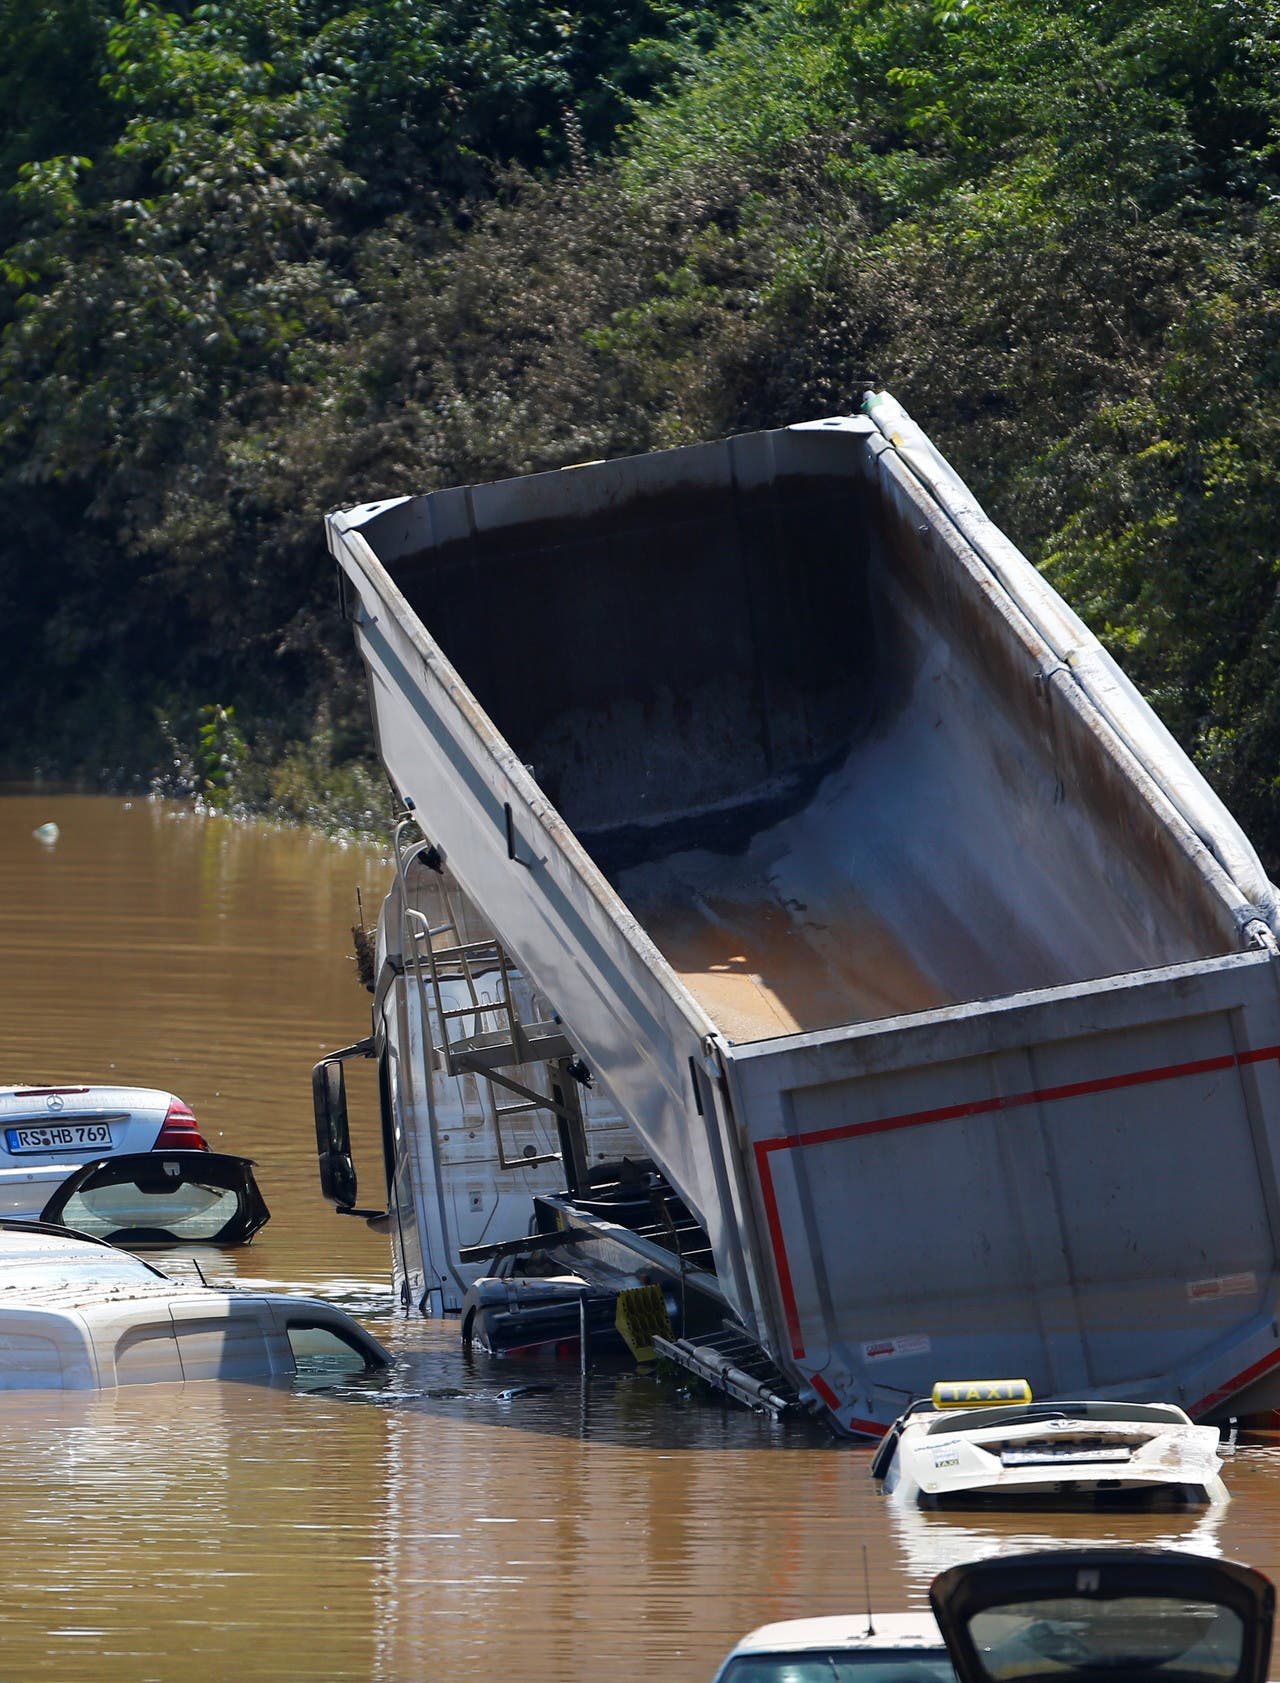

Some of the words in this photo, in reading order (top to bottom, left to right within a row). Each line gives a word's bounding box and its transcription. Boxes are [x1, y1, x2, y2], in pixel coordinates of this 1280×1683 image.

[18, 1131, 41, 1146] RS
[51, 1129, 73, 1145] HB
[76, 1127, 107, 1142] 769
[951, 1386, 1014, 1400] TAXI
